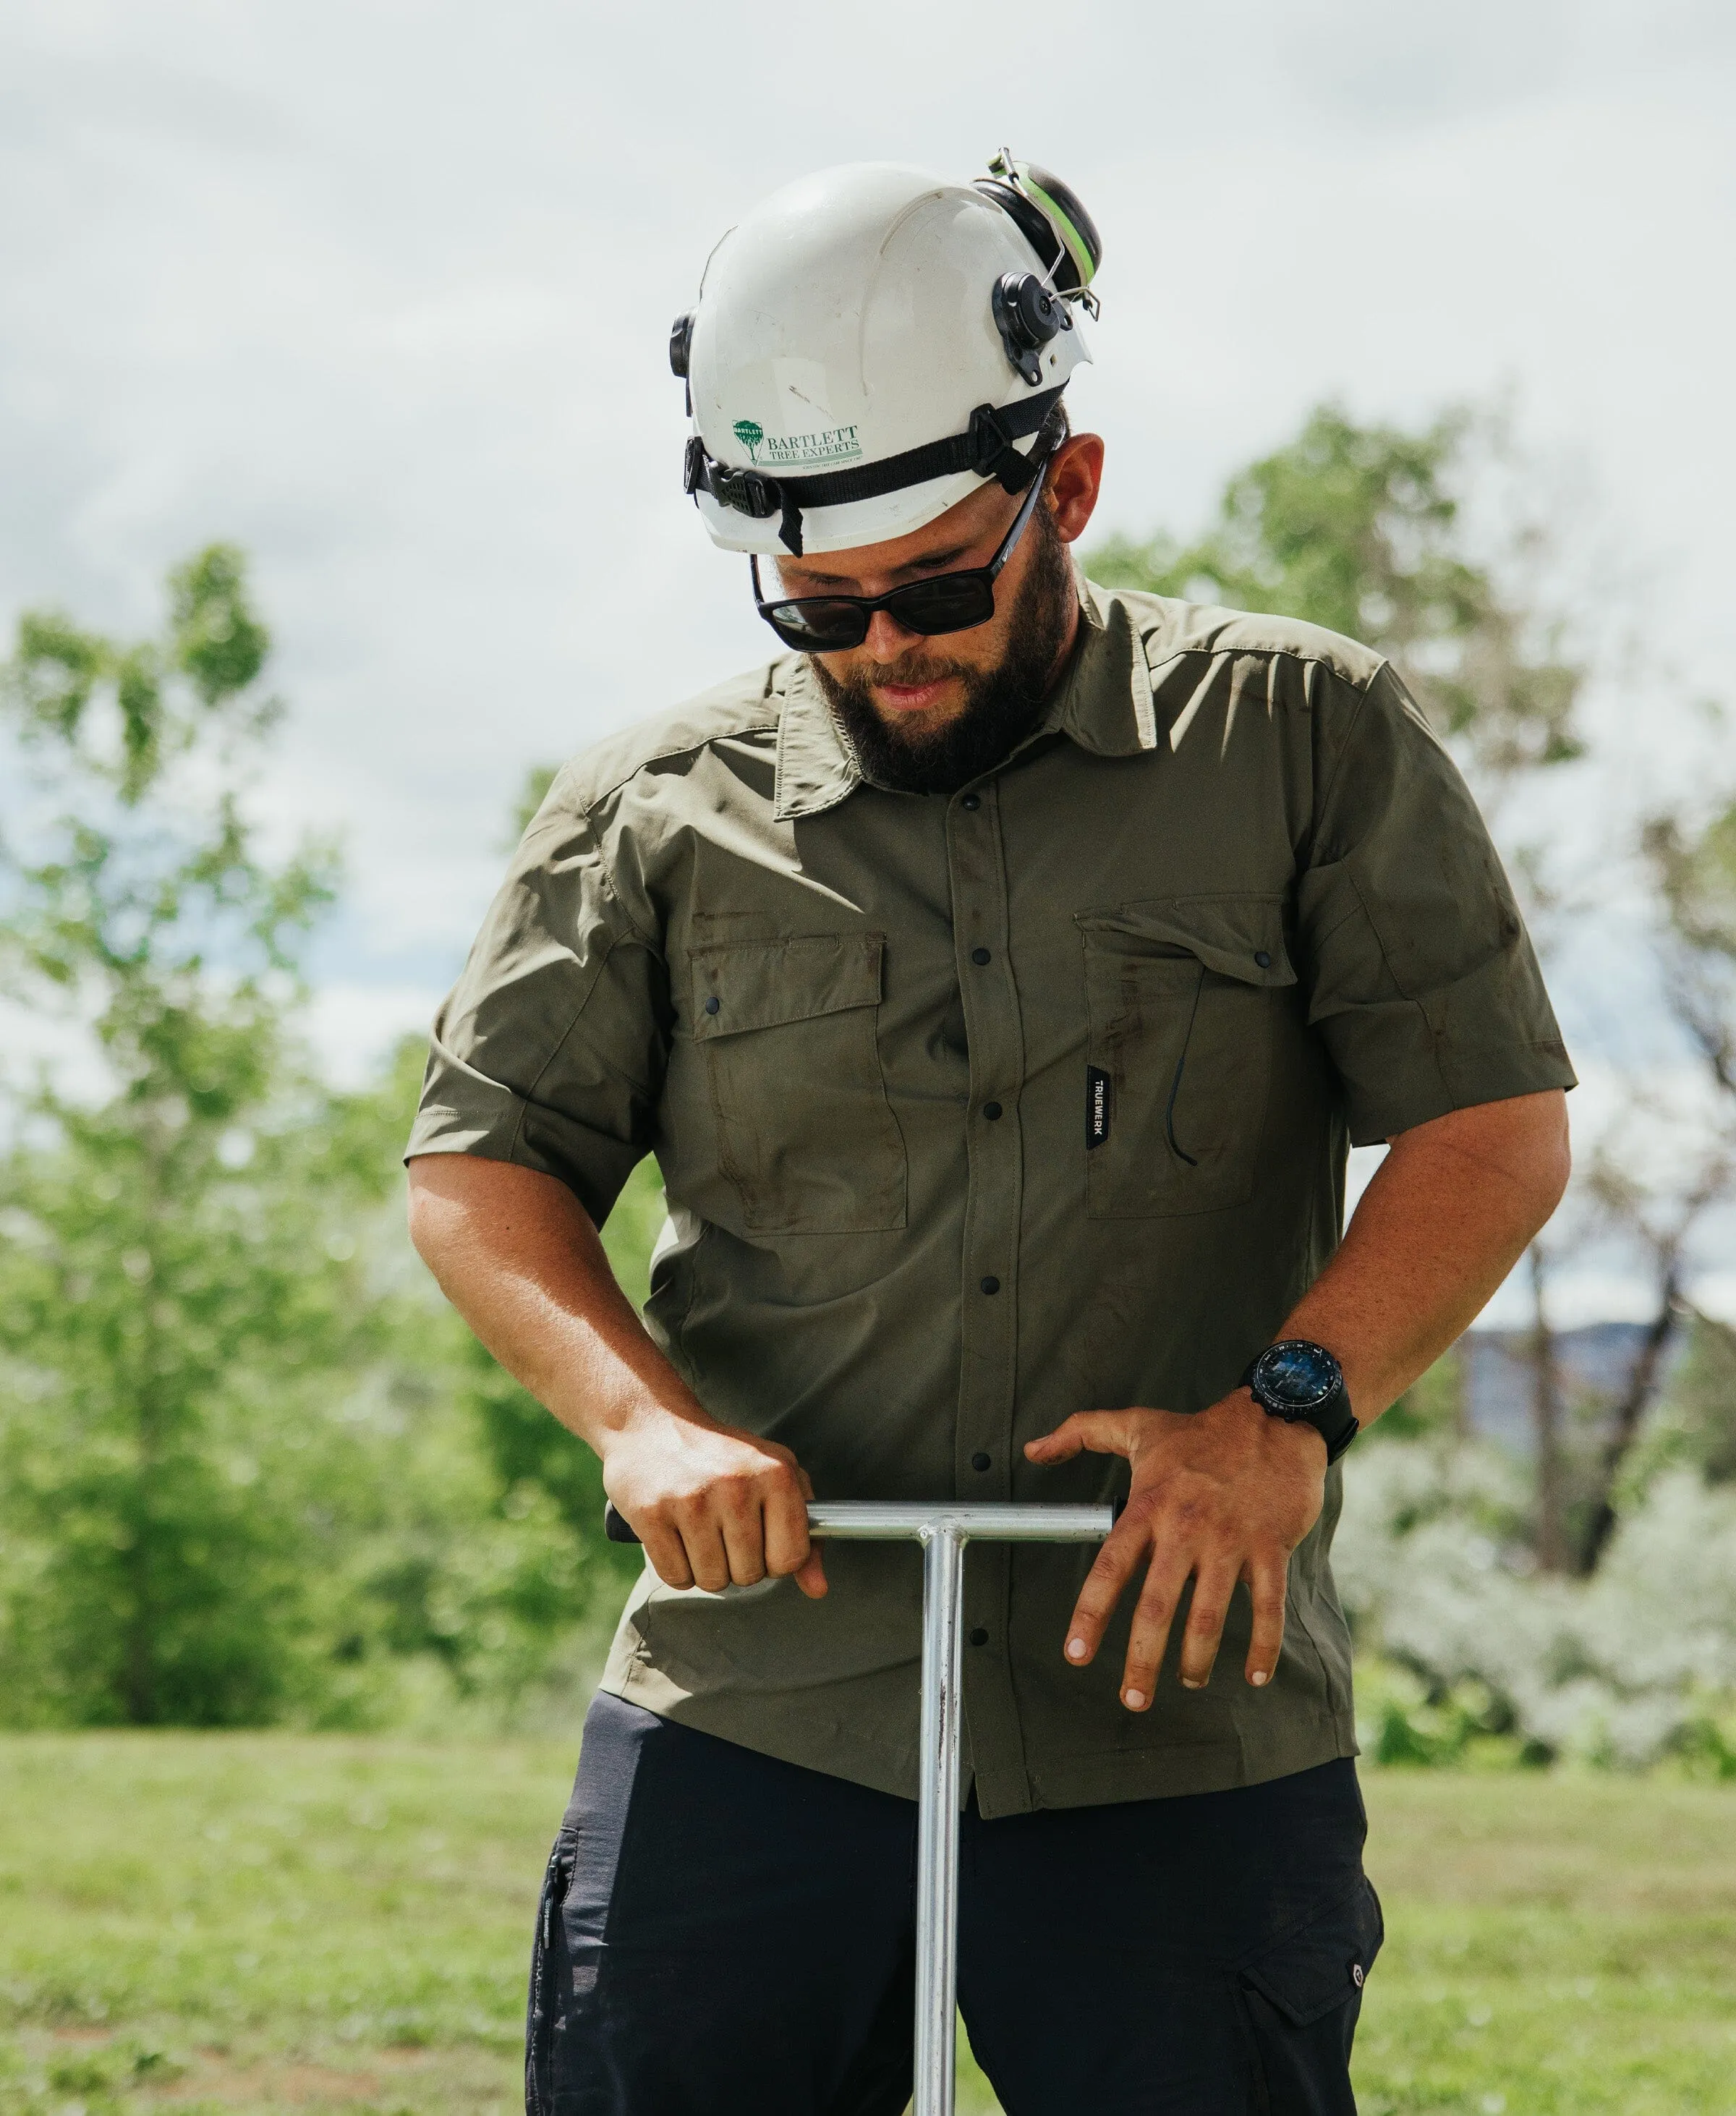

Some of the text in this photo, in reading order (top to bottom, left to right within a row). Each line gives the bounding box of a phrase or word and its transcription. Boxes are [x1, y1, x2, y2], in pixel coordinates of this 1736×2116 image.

[767, 425, 858, 450] BARTLETT
[769, 439, 859, 460] TREE EXPERTS
[1094, 1080, 1104, 1136] TRUEWERK
